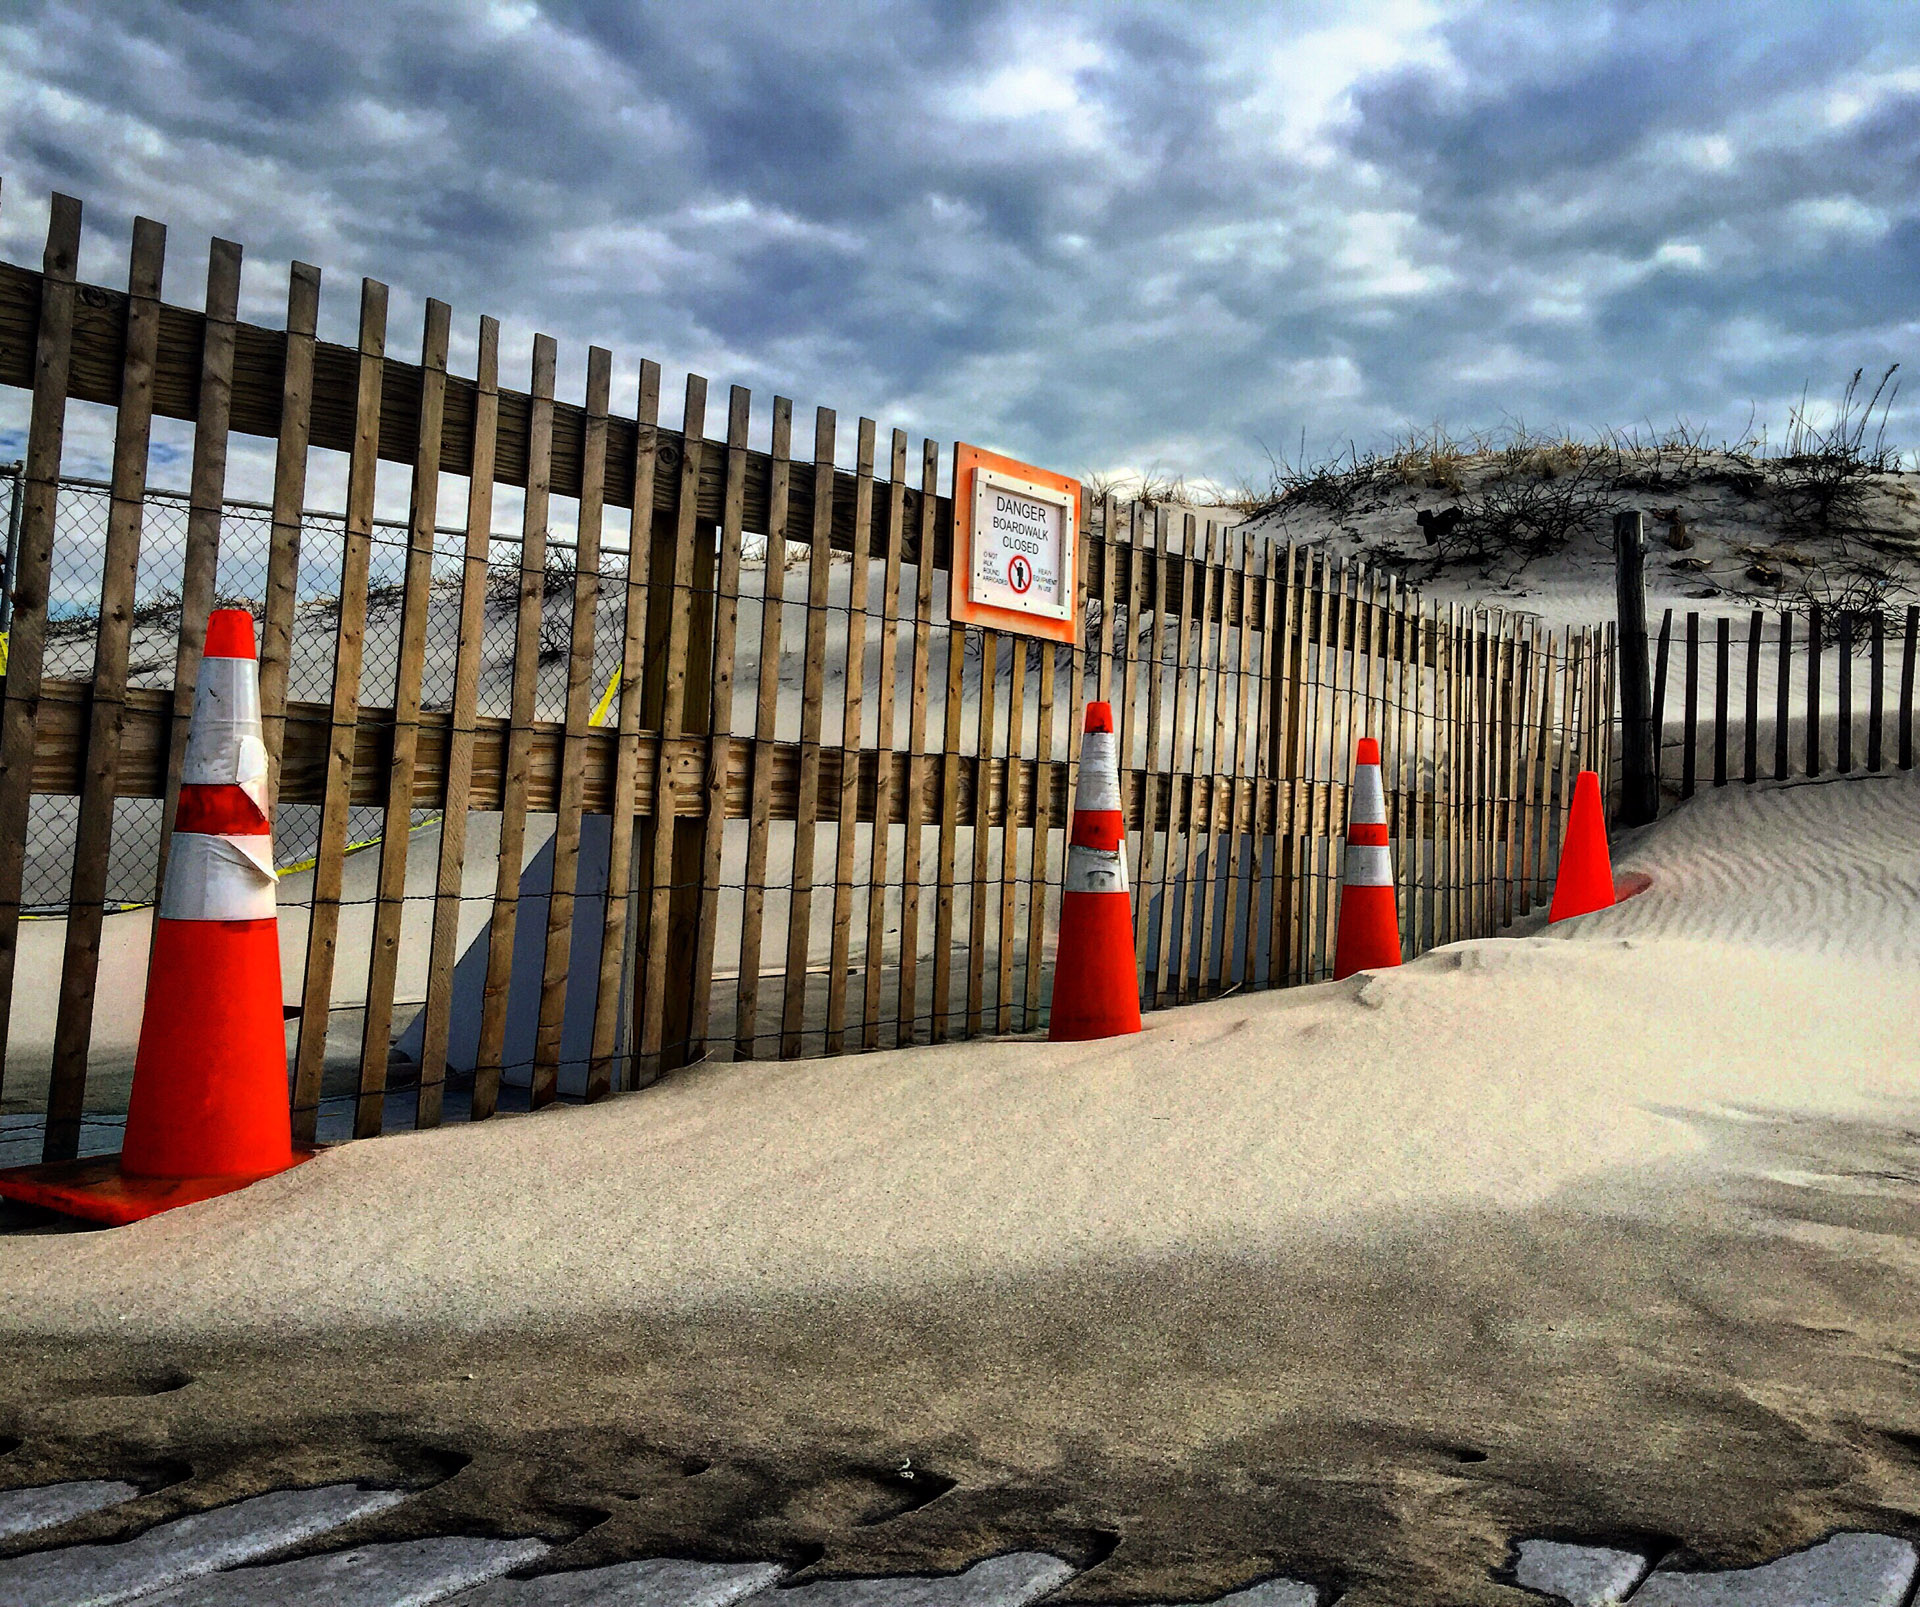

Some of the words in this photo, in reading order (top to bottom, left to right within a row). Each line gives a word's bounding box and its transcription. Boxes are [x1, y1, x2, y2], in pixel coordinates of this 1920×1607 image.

[996, 496, 1046, 524] DANGER
[993, 516, 1048, 541] BOARDWALK
[1002, 535, 1039, 555] CLOSED
